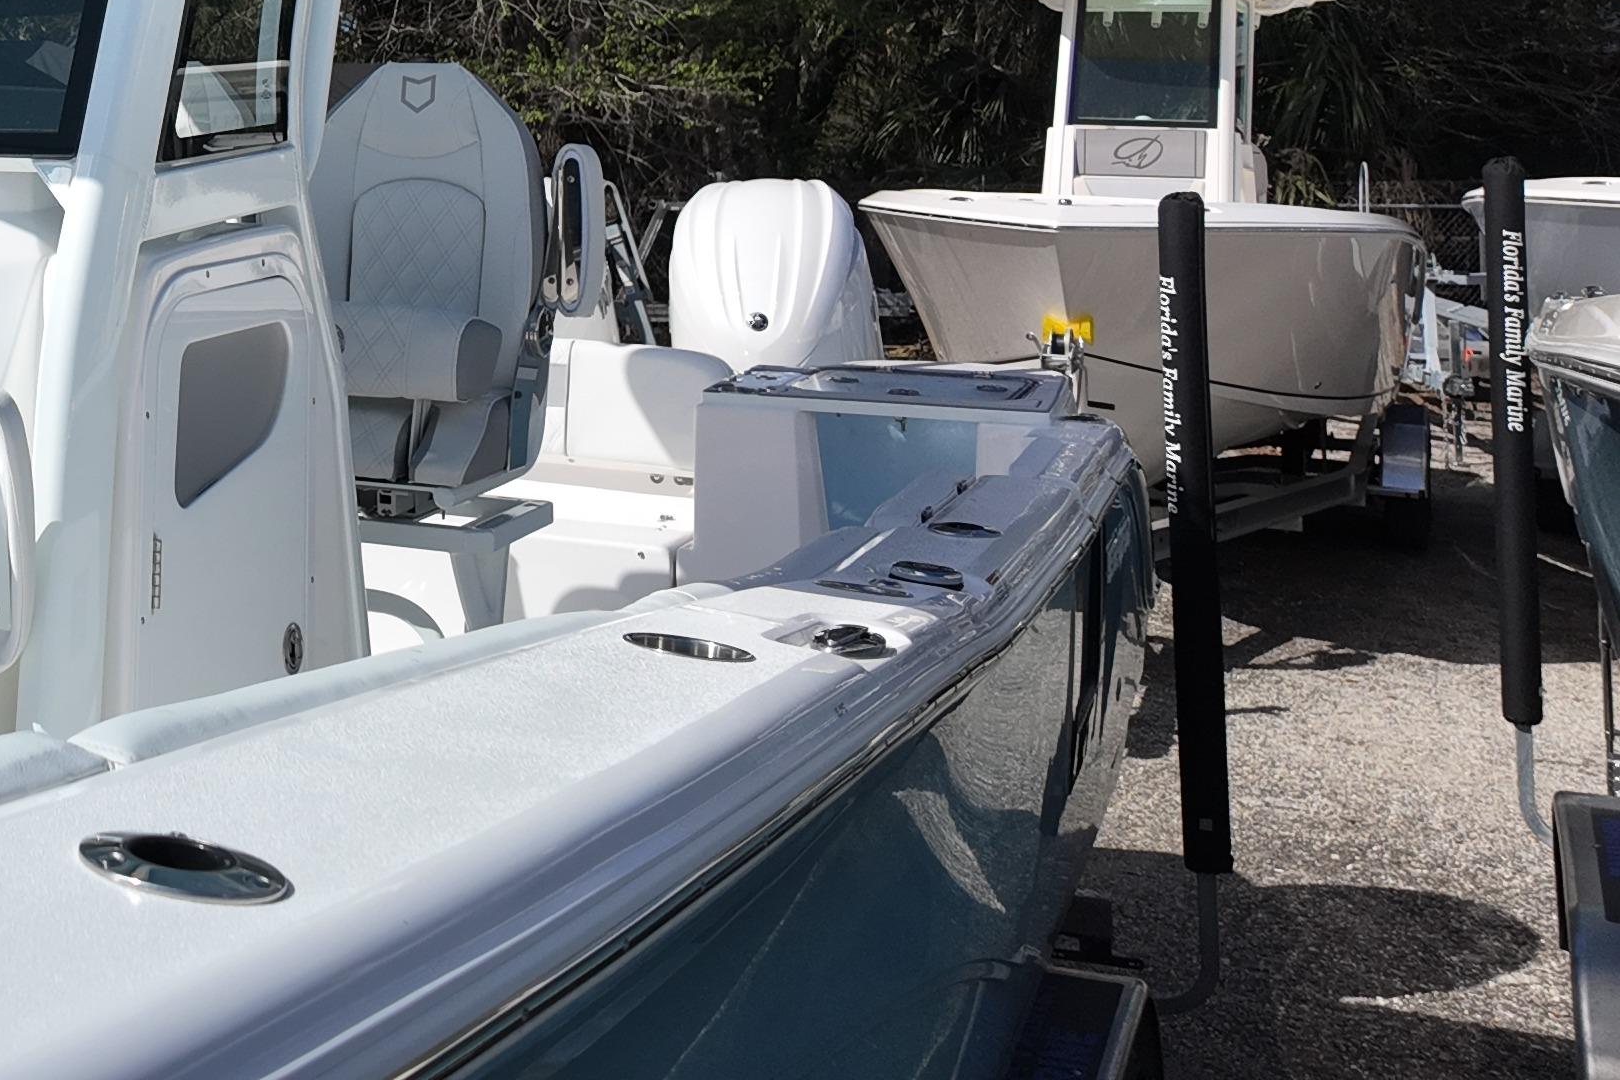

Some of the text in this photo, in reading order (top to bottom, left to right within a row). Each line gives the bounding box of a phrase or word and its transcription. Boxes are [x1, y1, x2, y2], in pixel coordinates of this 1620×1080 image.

[1159, 275, 1184, 514] Florida's Family Marine
[1499, 229, 1529, 432] Florida's Family Marine
